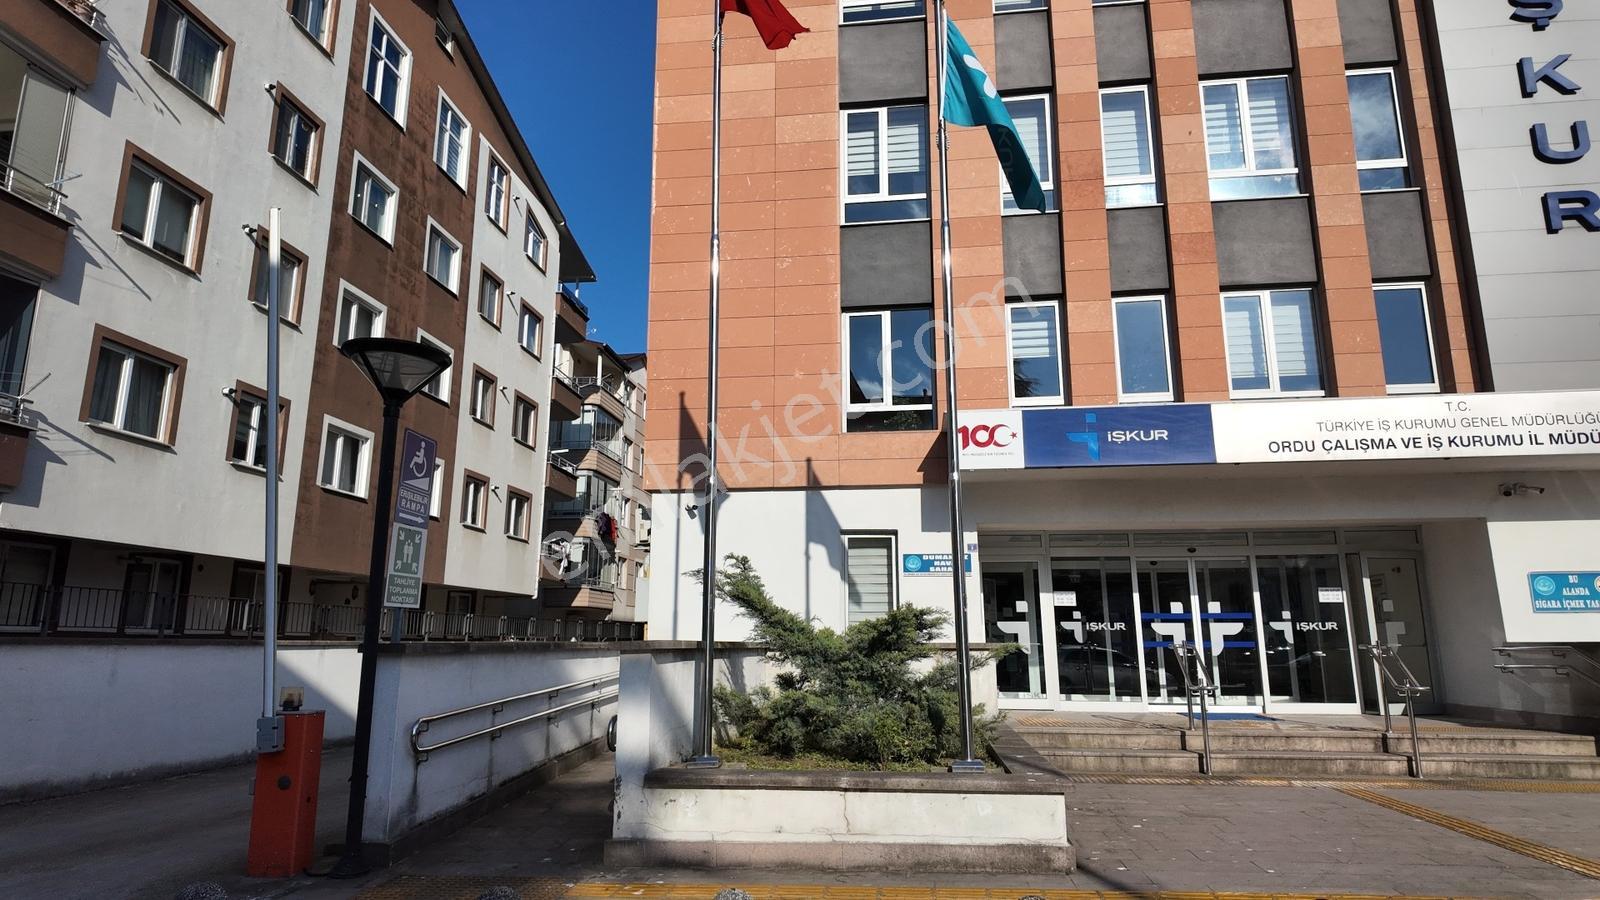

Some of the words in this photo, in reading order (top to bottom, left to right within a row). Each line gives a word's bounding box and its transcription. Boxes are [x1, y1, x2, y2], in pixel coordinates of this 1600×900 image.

[1445, 401, 1471, 412] T.C.
[1316, 418, 1374, 432] TÜRKİYE
[1377, 418, 1391, 432] İŞ
[1395, 417, 1456, 431] KURUMU
[1461, 416, 1508, 428] GENEL
[1268, 440, 1315, 453] ORDU
[1321, 438, 1397, 454] ÇALIŞMA
[1401, 437, 1422, 449] VE
[1427, 433, 1443, 451] İŞ
[1449, 434, 1524, 449] KURUMU
[1528, 430, 1544, 445] İL
[401, 498, 425, 514] RAMPA
[1568, 575, 1578, 583] BU
[1562, 587, 1590, 596] ALANDA
